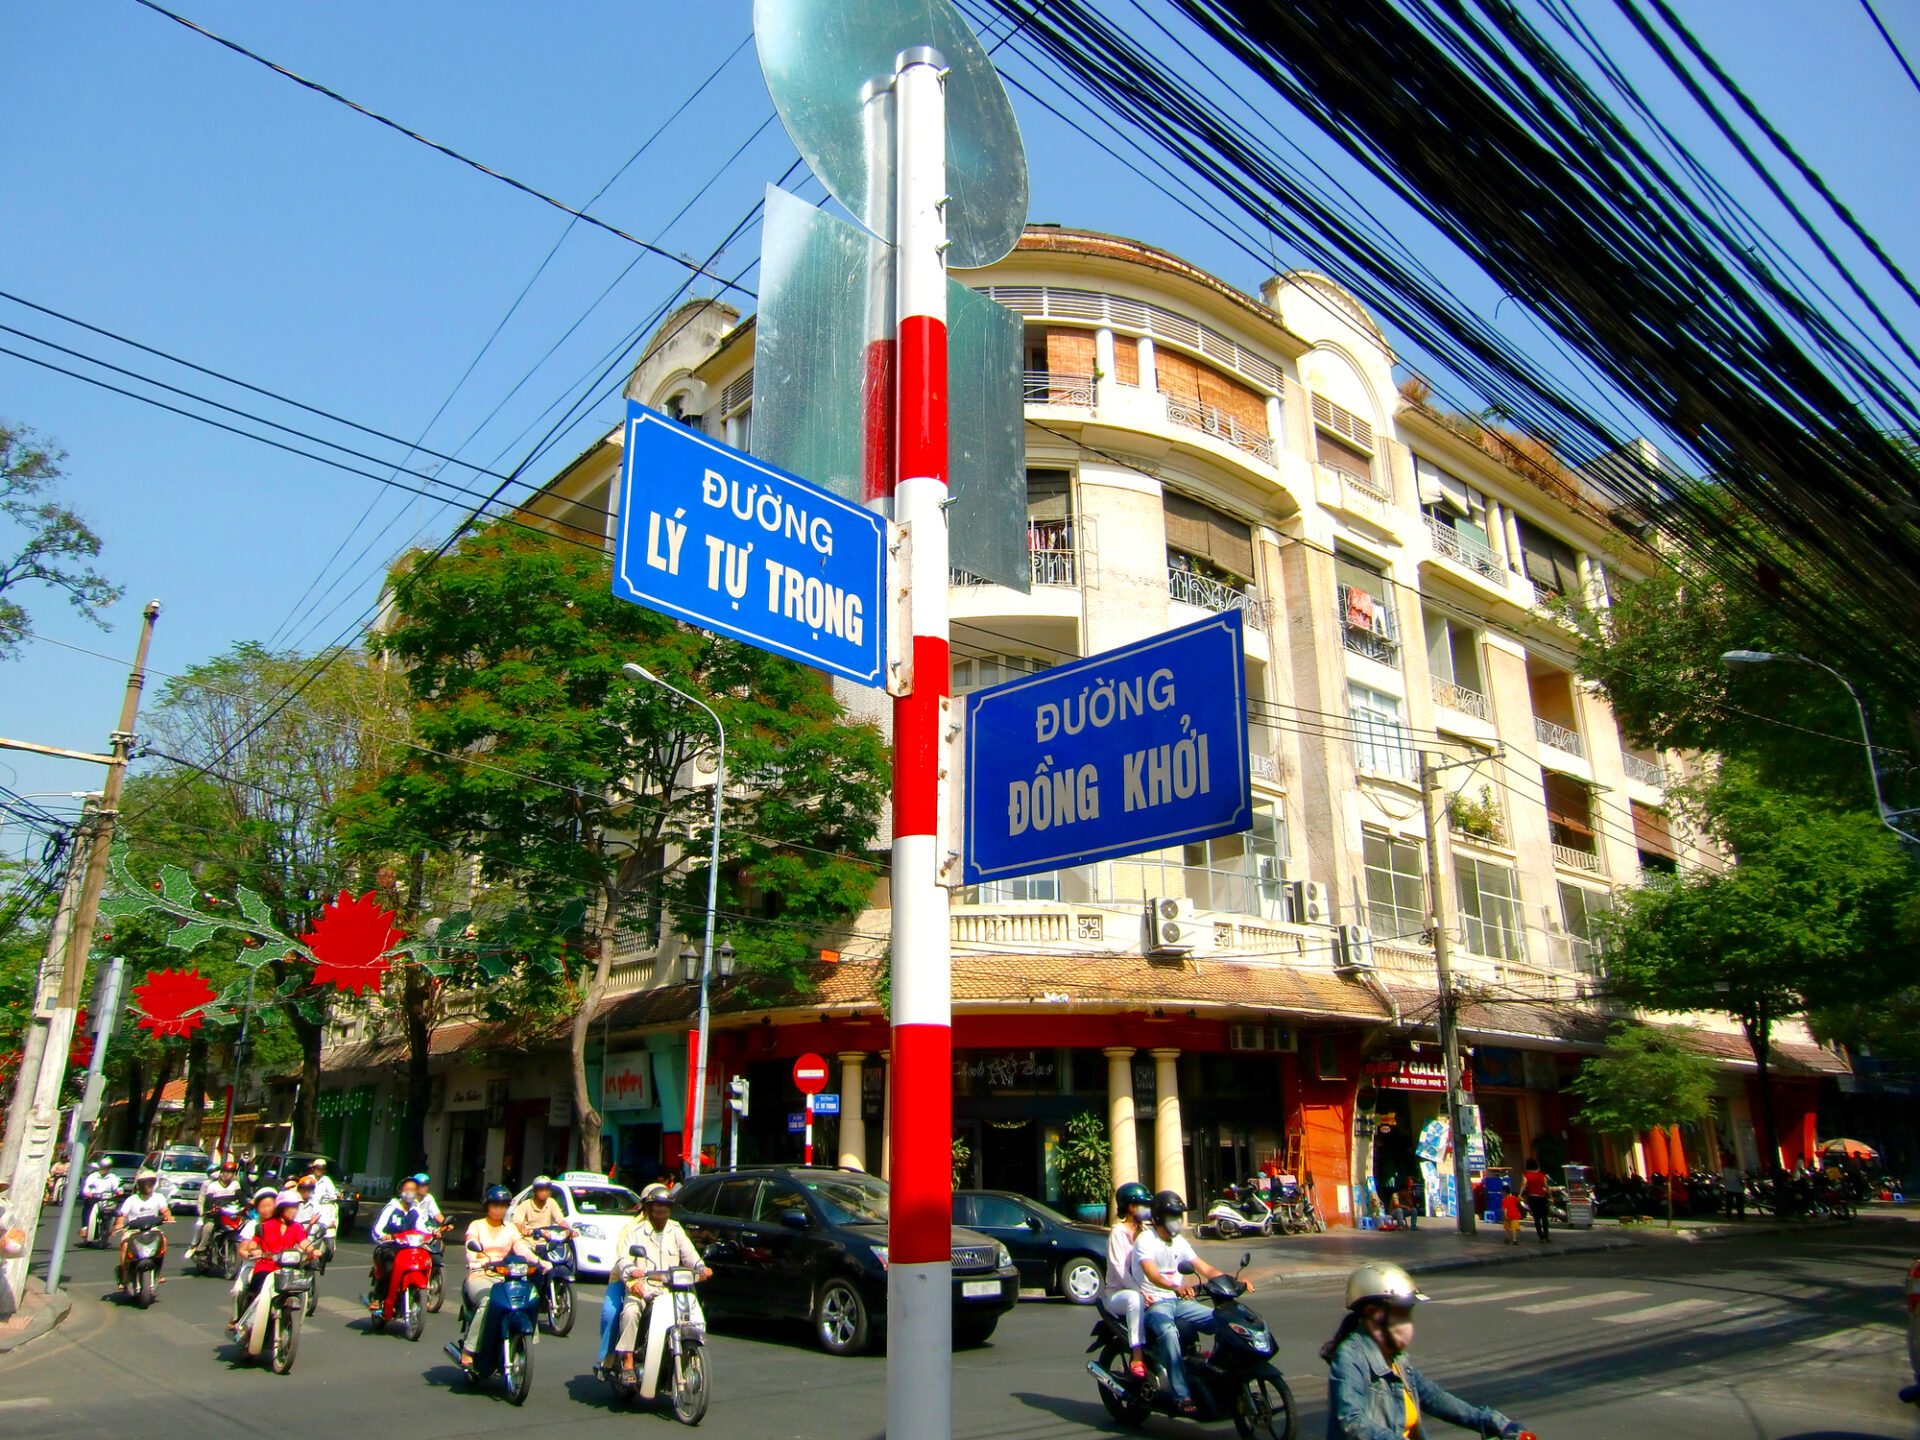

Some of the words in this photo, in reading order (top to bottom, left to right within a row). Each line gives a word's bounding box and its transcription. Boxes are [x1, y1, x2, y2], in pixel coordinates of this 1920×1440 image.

[702, 468, 833, 557] ĐƯỜNG
[646, 507, 688, 576] LÝ
[705, 526, 754, 611] TỰ
[765, 558, 864, 647] TRỌNG
[1035, 668, 1176, 744] ĐƯỜNG
[1007, 754, 1100, 837] ĐỒNG
[1123, 714, 1210, 813] KHỞI
